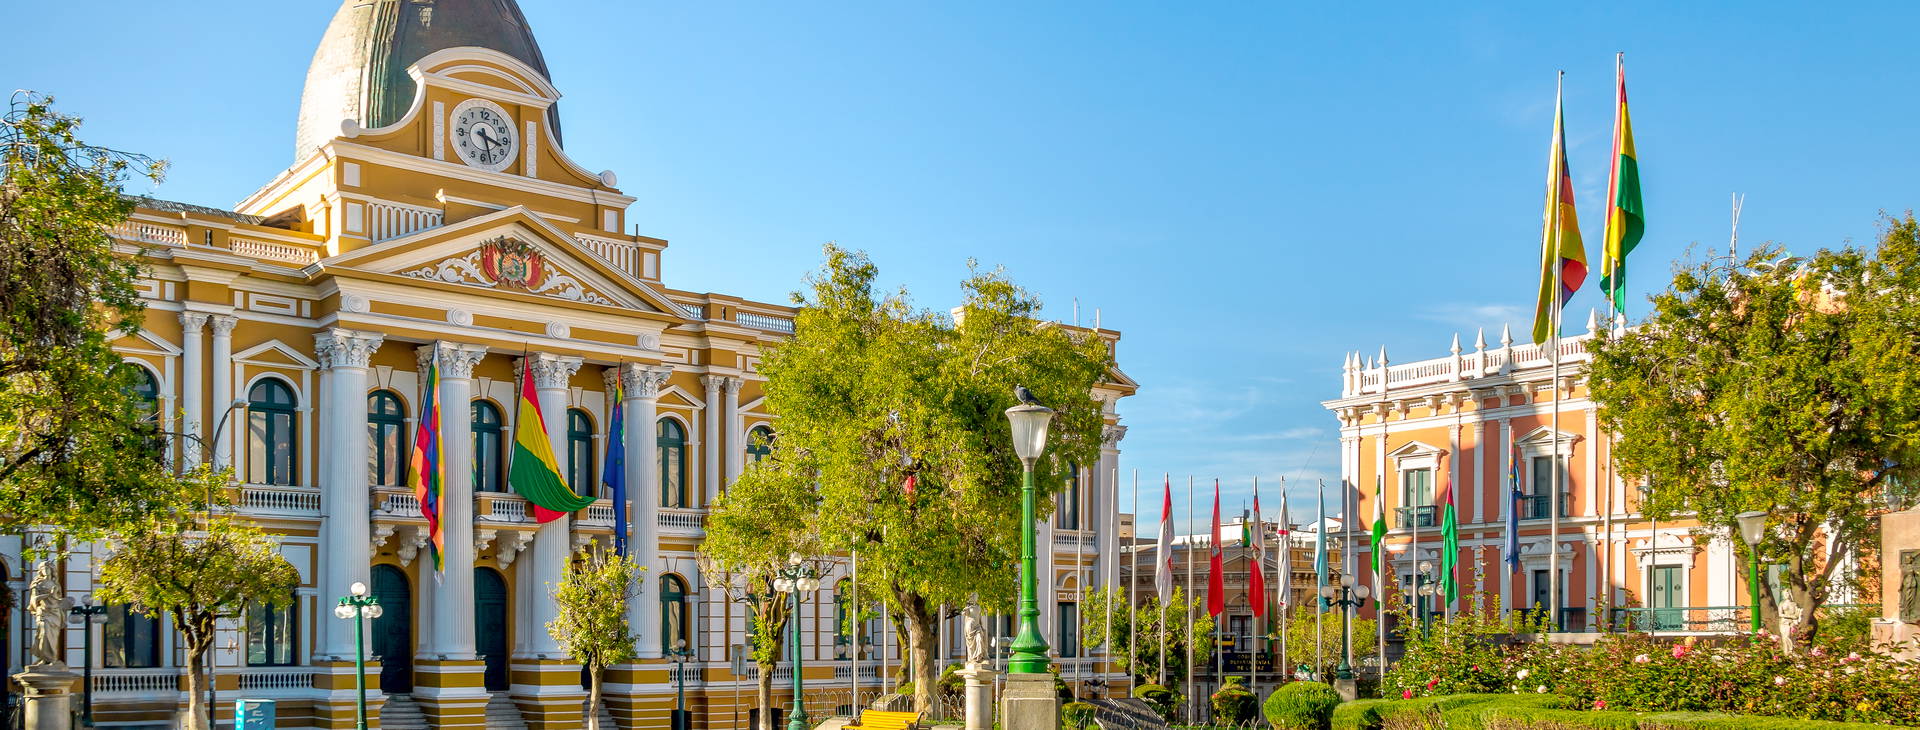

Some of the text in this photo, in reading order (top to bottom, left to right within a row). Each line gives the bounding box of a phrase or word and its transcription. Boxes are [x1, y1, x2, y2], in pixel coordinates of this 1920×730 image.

[480, 111, 490, 120] 12
[458, 128, 464, 136] 3
[480, 154, 486, 162] 6
